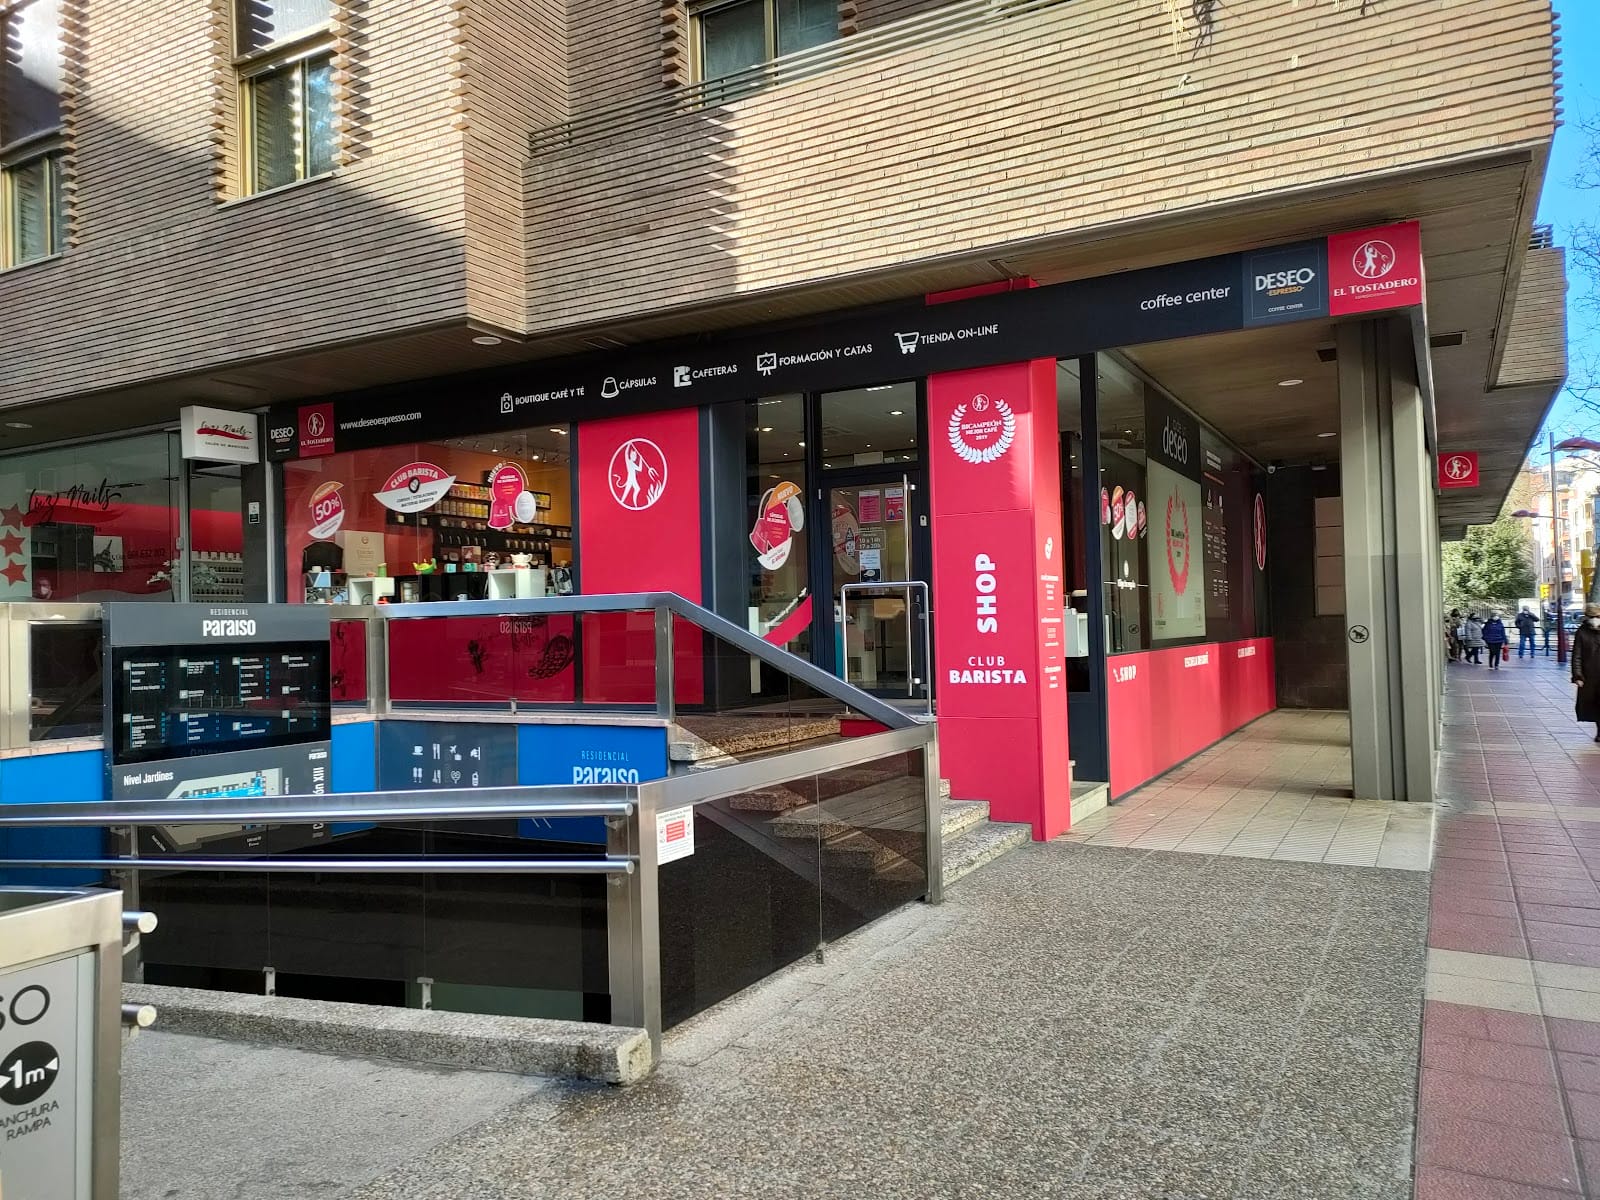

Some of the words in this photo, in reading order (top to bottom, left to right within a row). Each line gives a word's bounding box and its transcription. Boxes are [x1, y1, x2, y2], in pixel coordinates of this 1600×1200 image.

[1255, 268, 1315, 292] DESEO
[1333, 288, 1347, 297] EL
[1348, 277, 1418, 296] TOSTADERO
[1140, 291, 1182, 311] coffee
[1185, 285, 1231, 304] center
[1267, 285, 1304, 297] ESPRESSO
[920, 331, 955, 345] TIENDA
[956, 323, 999, 340] ON-LINE
[779, 349, 833, 366] FORMACIÓN
[835, 348, 841, 357] Y
[843, 343, 873, 356] CATAS
[692, 364, 738, 379] CAFETERAS
[619, 376, 657, 390] CÁPSULAS
[515, 392, 550, 405] BOUTIQUE
[550, 389, 569, 400] CAFÉ
[569, 388, 575, 397] Y
[575, 386, 585, 396] TÉ
[340, 411, 422, 431] www.deseoespresso.com
[270, 426, 295, 440] DESEO
[1162, 415, 1189, 465] deseo
[390, 471, 408, 489] CLUB
[407, 467, 439, 479] BARISTA
[315, 496, 340, 521] 50%
[975, 553, 998, 634] SHOP
[210, 608, 249, 616] RESIDENCIAL
[968, 656, 1006, 667] CLUB
[949, 669, 1028, 684] BARISTA
[581, 750, 630, 762] RESIDENCIAL
[124, 772, 142, 787] Nivel
[143, 770, 174, 785] Jardines
[8, 1059, 46, 1089] 1m
[6, 1117, 52, 1142] RAMPA
